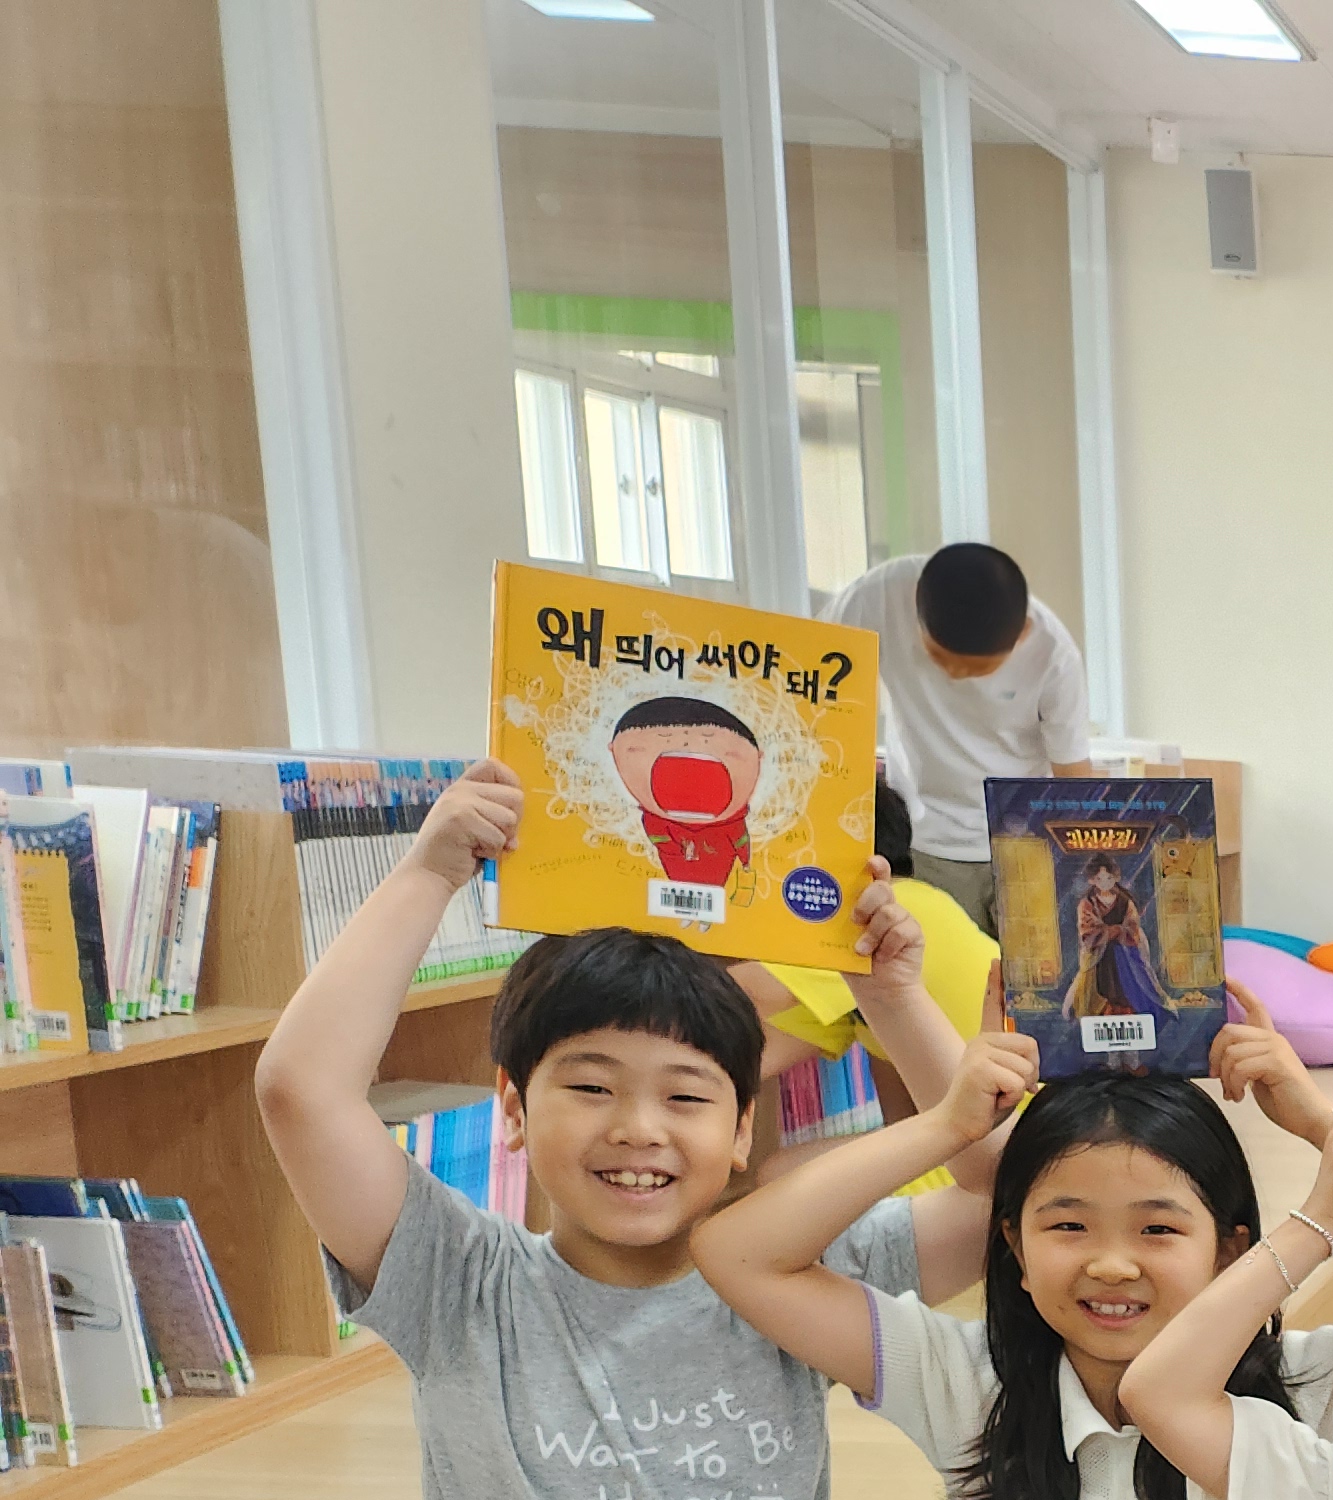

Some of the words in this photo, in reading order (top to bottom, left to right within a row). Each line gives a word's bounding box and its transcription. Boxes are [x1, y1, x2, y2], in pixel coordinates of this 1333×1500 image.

[537, 606, 604, 669] 왜
[696, 639, 780, 679] 써야
[786, 652, 853, 704] 돼?
[634, 1388, 746, 1431] Just
[749, 1419, 796, 1465] Be
